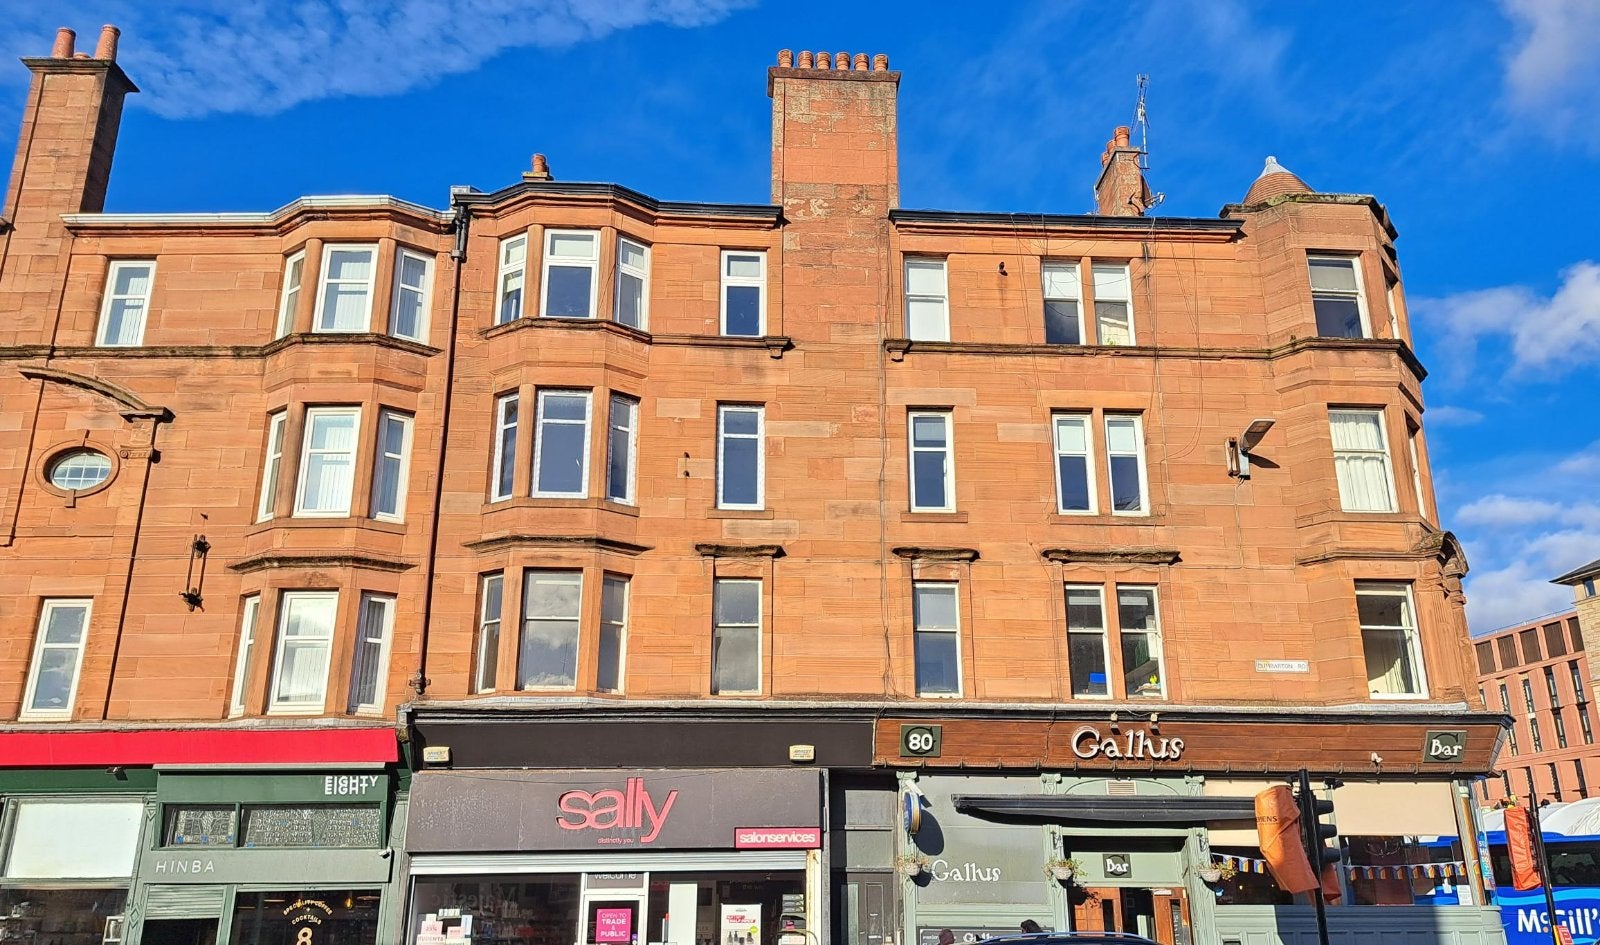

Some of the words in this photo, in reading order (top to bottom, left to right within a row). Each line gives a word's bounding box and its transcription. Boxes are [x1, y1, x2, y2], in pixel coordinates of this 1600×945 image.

[908, 733, 933, 751] 80
[1071, 725, 1185, 759] Gallus
[1430, 739, 1463, 756] Bar
[324, 784, 369, 795] EIGHT
[325, 775, 379, 787] EIGHTY
[556, 776, 679, 843] sally
[597, 837, 623, 845] distinctly
[623, 837, 635, 845] you
[739, 830, 817, 844] salonservices
[155, 860, 215, 873] HINBA
[931, 859, 1001, 882] Gallus
[1105, 858, 1129, 872] Bar
[1517, 908, 1600, 935] Mcill'
[295, 926, 313, 945] 8
